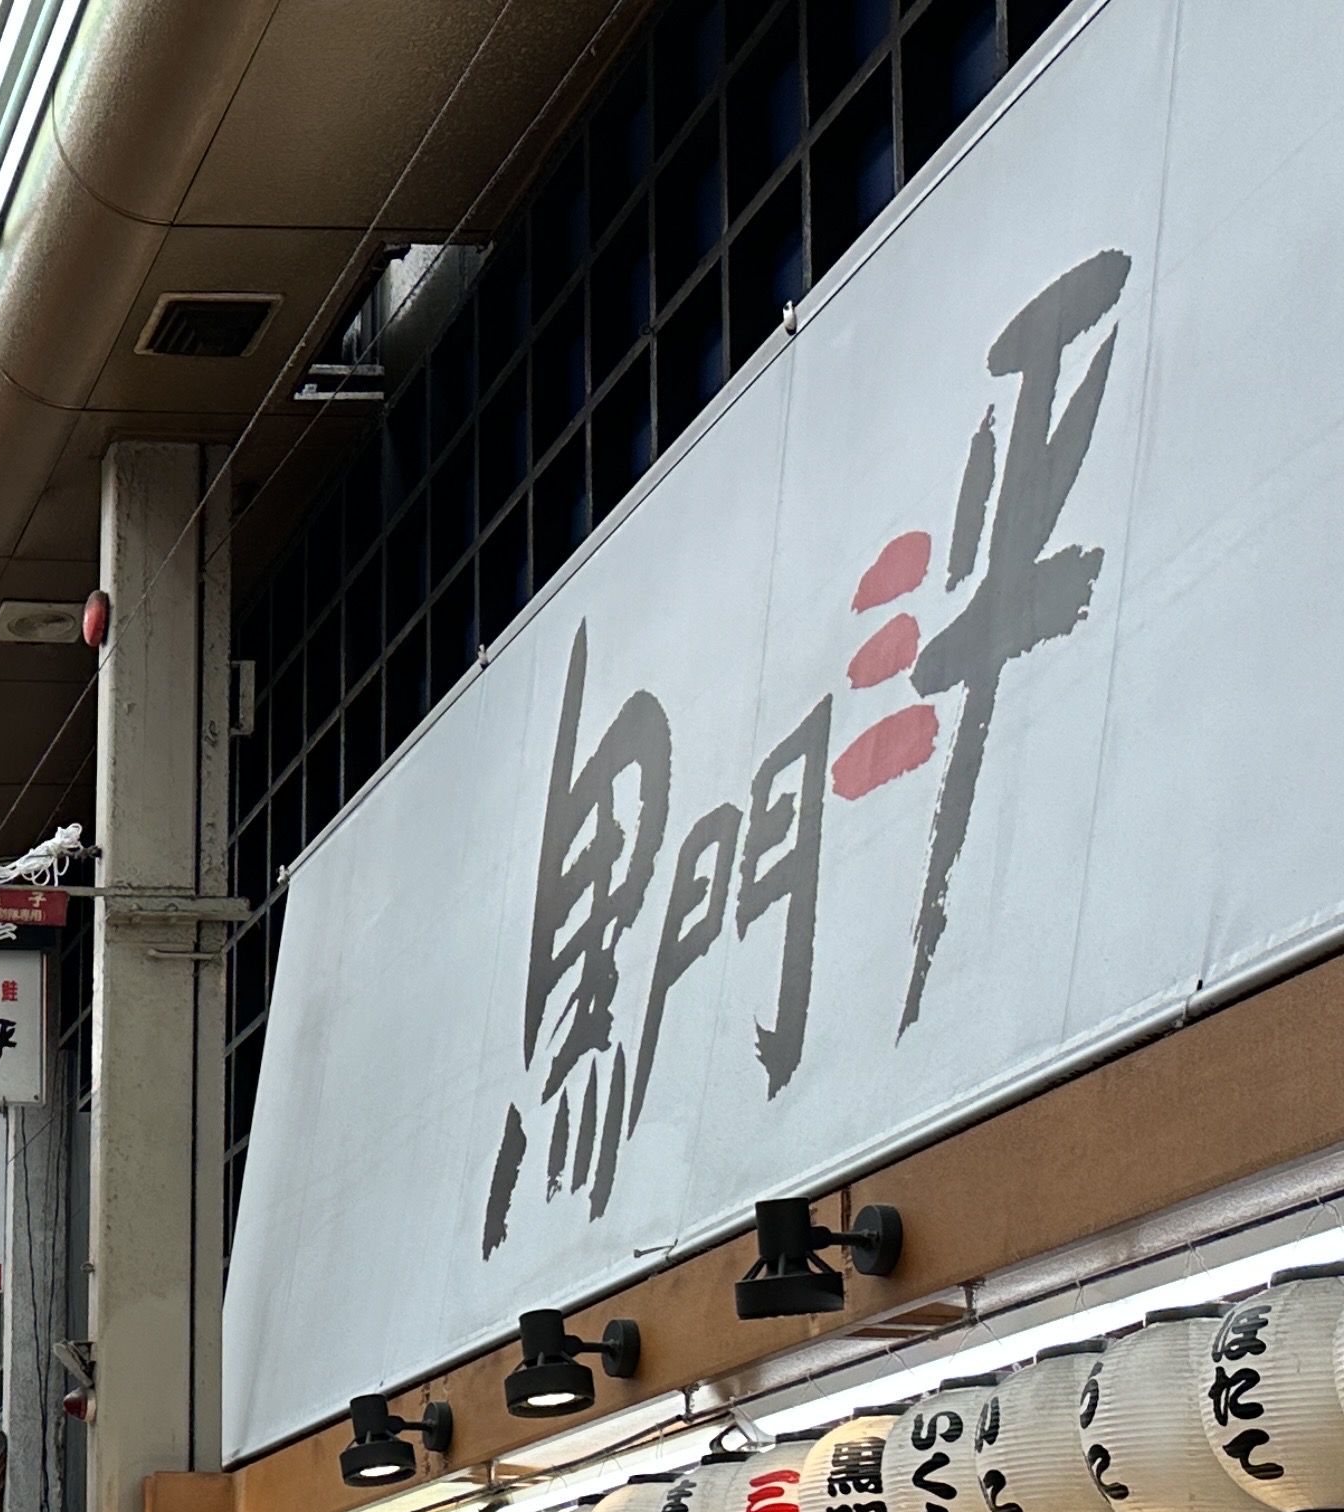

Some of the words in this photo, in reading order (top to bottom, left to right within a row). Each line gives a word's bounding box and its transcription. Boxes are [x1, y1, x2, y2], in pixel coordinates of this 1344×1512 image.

[482, 249, 1132, 1262] 黒門三平
[1209, 1305, 1285, 1480] ほたて
